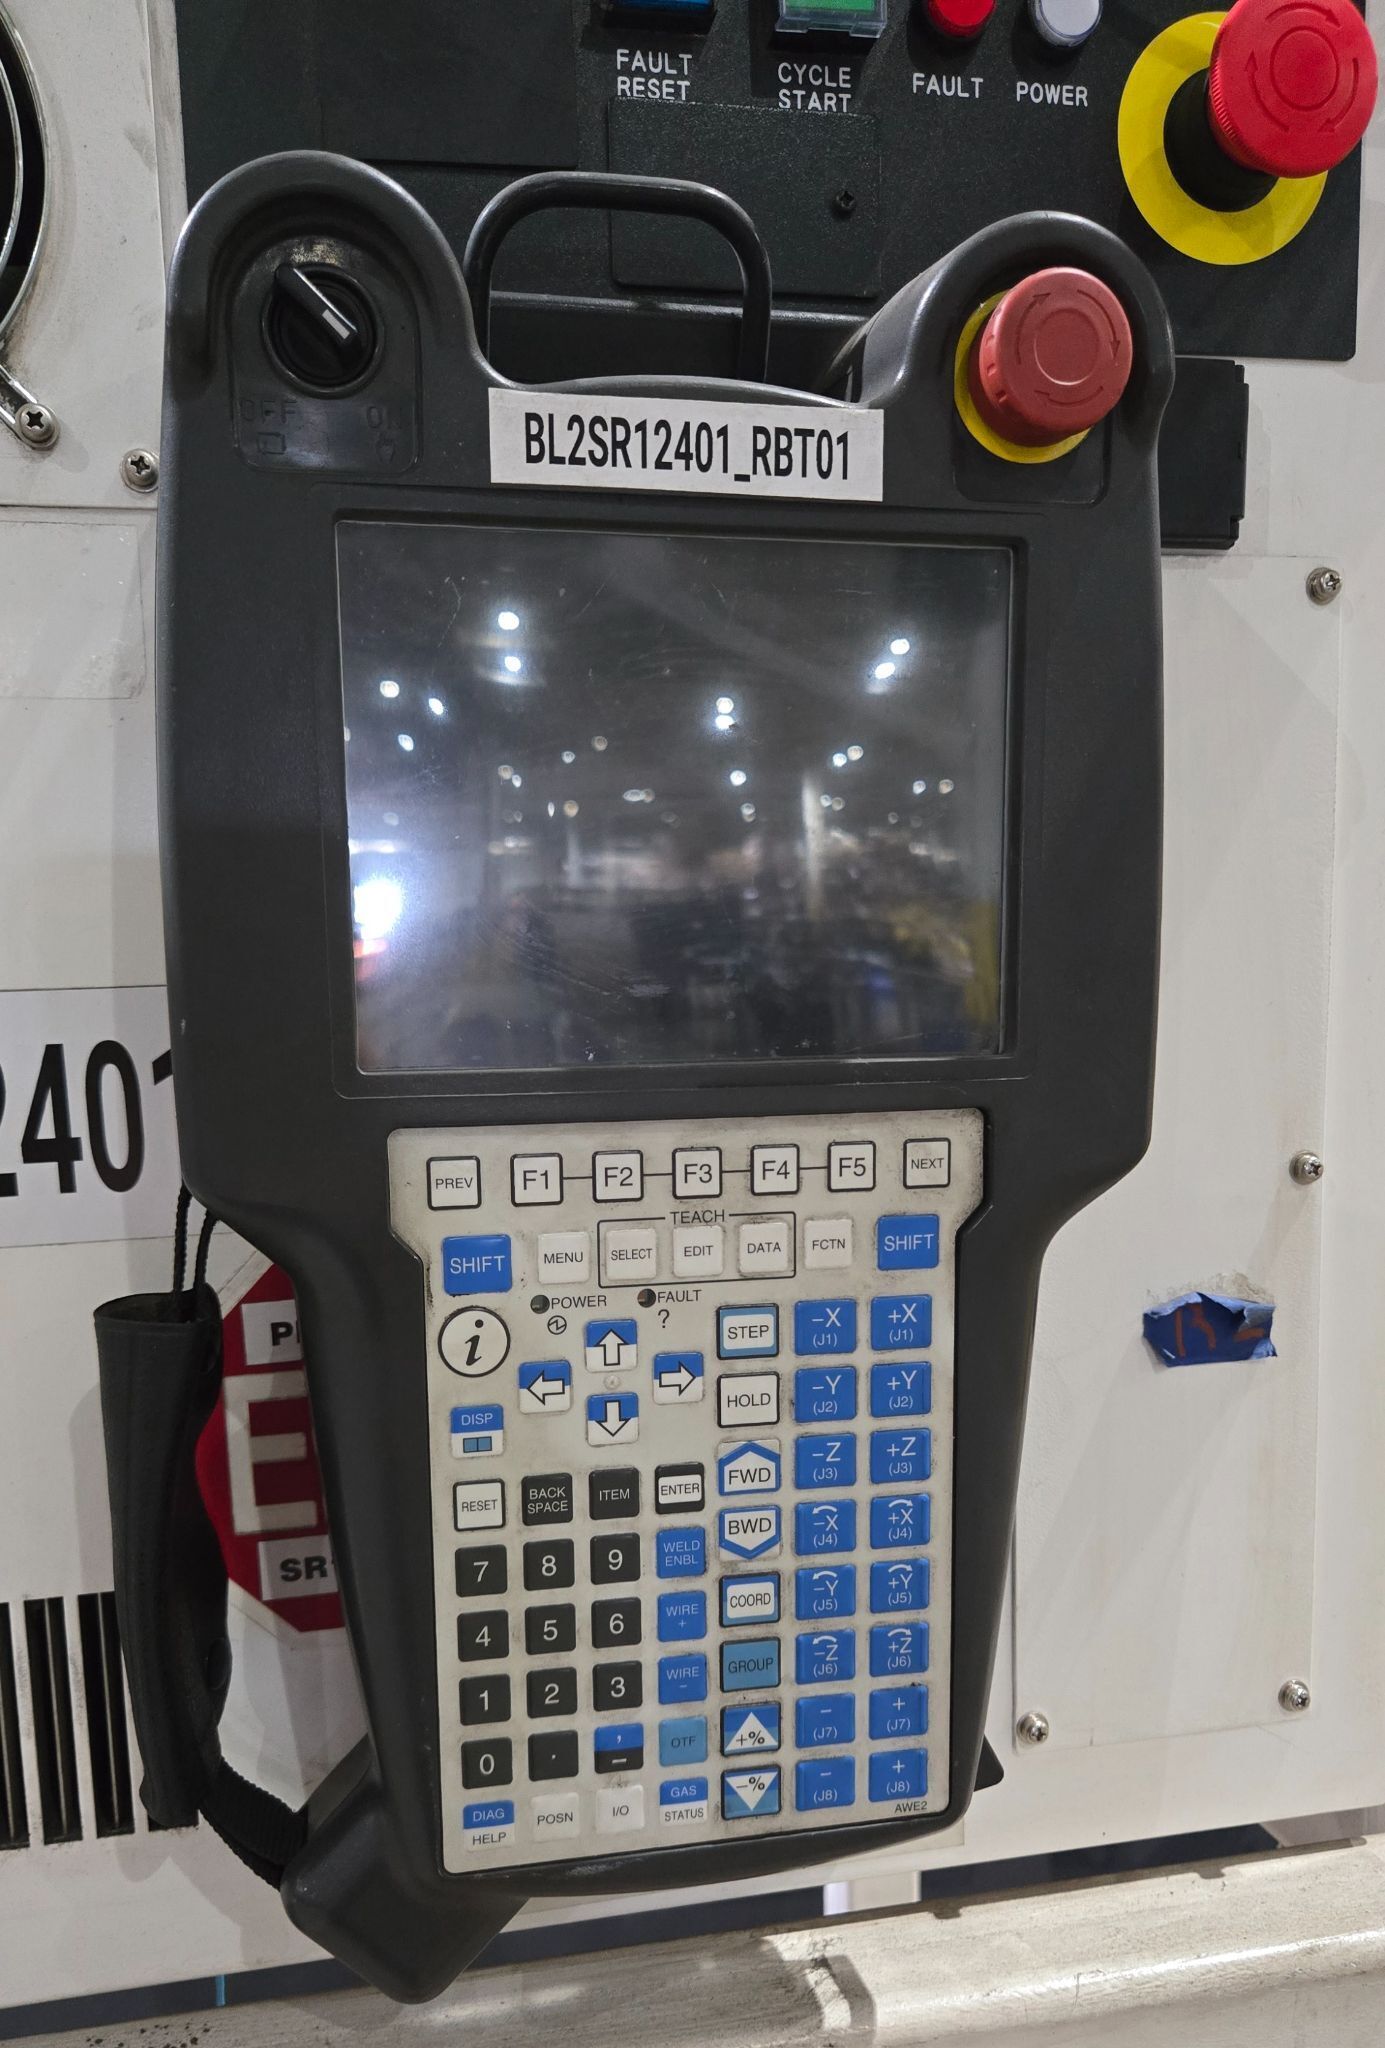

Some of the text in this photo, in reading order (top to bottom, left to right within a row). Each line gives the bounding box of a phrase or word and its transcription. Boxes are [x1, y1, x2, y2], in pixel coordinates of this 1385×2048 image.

[617, 49, 692, 75] FAULT
[778, 62, 851, 88] CYCLE
[617, 77, 690, 100] RESET
[912, 73, 983, 98] FAULT
[779, 89, 851, 112] START
[1016, 81, 1088, 107] POWER
[524, 412, 849, 482] BL2SR12401_RBT01
[762, 1160, 790, 1180] F4
[839, 1157, 867, 1177] F5
[911, 1157, 945, 1170] NEXT
[523, 1169, 549, 1190] F1
[604, 1167, 633, 1187] F2
[684, 1163, 713, 1184] F3
[435, 1177, 473, 1189] PREV
[670, 1209, 725, 1225] TEACH
[747, 1241, 782, 1254] DATA
[812, 1238, 846, 1251] FCTN
[884, 1233, 935, 1251] SHIFT
[543, 1251, 584, 1264] MENU
[610, 1248, 653, 1261] SELECT
[684, 1245, 714, 1257] EDIT
[449, 1255, 505, 1275] SHIFT
[551, 1295, 607, 1310] POWER
[657, 1289, 702, 1304] FAULT
[888, 1303, 918, 1324] +X
[270, 1320, 300, 1346] P
[727, 1324, 770, 1340] STEP
[889, 1329, 914, 1343] (J1)
[813, 1333, 838, 1348] (J1)
[887, 1369, 917, 1390] +Y
[727, 1393, 771, 1408] HOLD
[813, 1401, 838, 1415] (J2)
[889, 1396, 913, 1410] (J2)
[461, 1413, 493, 1426] DISP
[887, 1436, 917, 1457] +Z
[728, 1467, 771, 1485] FWD
[813, 1468, 838, 1482] (J3)
[889, 1462, 913, 1476] (J3)
[529, 1487, 566, 1500] BACK
[599, 1488, 630, 1501] ITEM
[660, 1483, 700, 1496] ENTER
[461, 1499, 497, 1513] RESET
[527, 1500, 569, 1514] SPACE
[888, 1508, 914, 1525] +X
[728, 1517, 772, 1535] BWD
[813, 1533, 838, 1547] (J4)
[889, 1527, 912, 1541] (J4)
[663, 1540, 700, 1553] WELD
[541, 1555, 557, 1576] 8
[608, 1549, 623, 1571] 9
[665, 1554, 698, 1566] ENBL
[280, 1558, 334, 1582] SR
[473, 1561, 489, 1582] 7
[888, 1573, 913, 1590] +Y
[730, 1592, 771, 1609] COORD
[813, 1598, 838, 1612] (J5)
[888, 1591, 912, 1605] (J5)
[666, 1604, 699, 1616] WIRE
[543, 1620, 559, 1641] 5
[609, 1613, 624, 1635] 6
[475, 1625, 492, 1647] 4
[888, 1637, 912, 1654] +Z
[728, 1657, 774, 1674] GROUP
[888, 1655, 912, 1669] (J6)
[666, 1666, 700, 1680] WIRE
[813, 1663, 838, 1678] (J6)
[544, 1683, 560, 1705] 2
[610, 1676, 626, 1698] 3
[479, 1690, 489, 1712] 1
[887, 1718, 911, 1733] (J7)
[813, 1727, 838, 1741] (J7)
[671, 1736, 697, 1748] OTF
[479, 1753, 495, 1776] 0
[671, 1786, 697, 1798] GAS
[886, 1780, 910, 1795] (J8)
[813, 1789, 838, 1803] (J8)
[472, 1808, 505, 1822] DIAG
[612, 1805, 629, 1818] I/O
[664, 1808, 704, 1821] STATUS
[895, 1801, 928, 1814] AWE2
[537, 1812, 574, 1826] POSN
[472, 1831, 507, 1845] HELP
